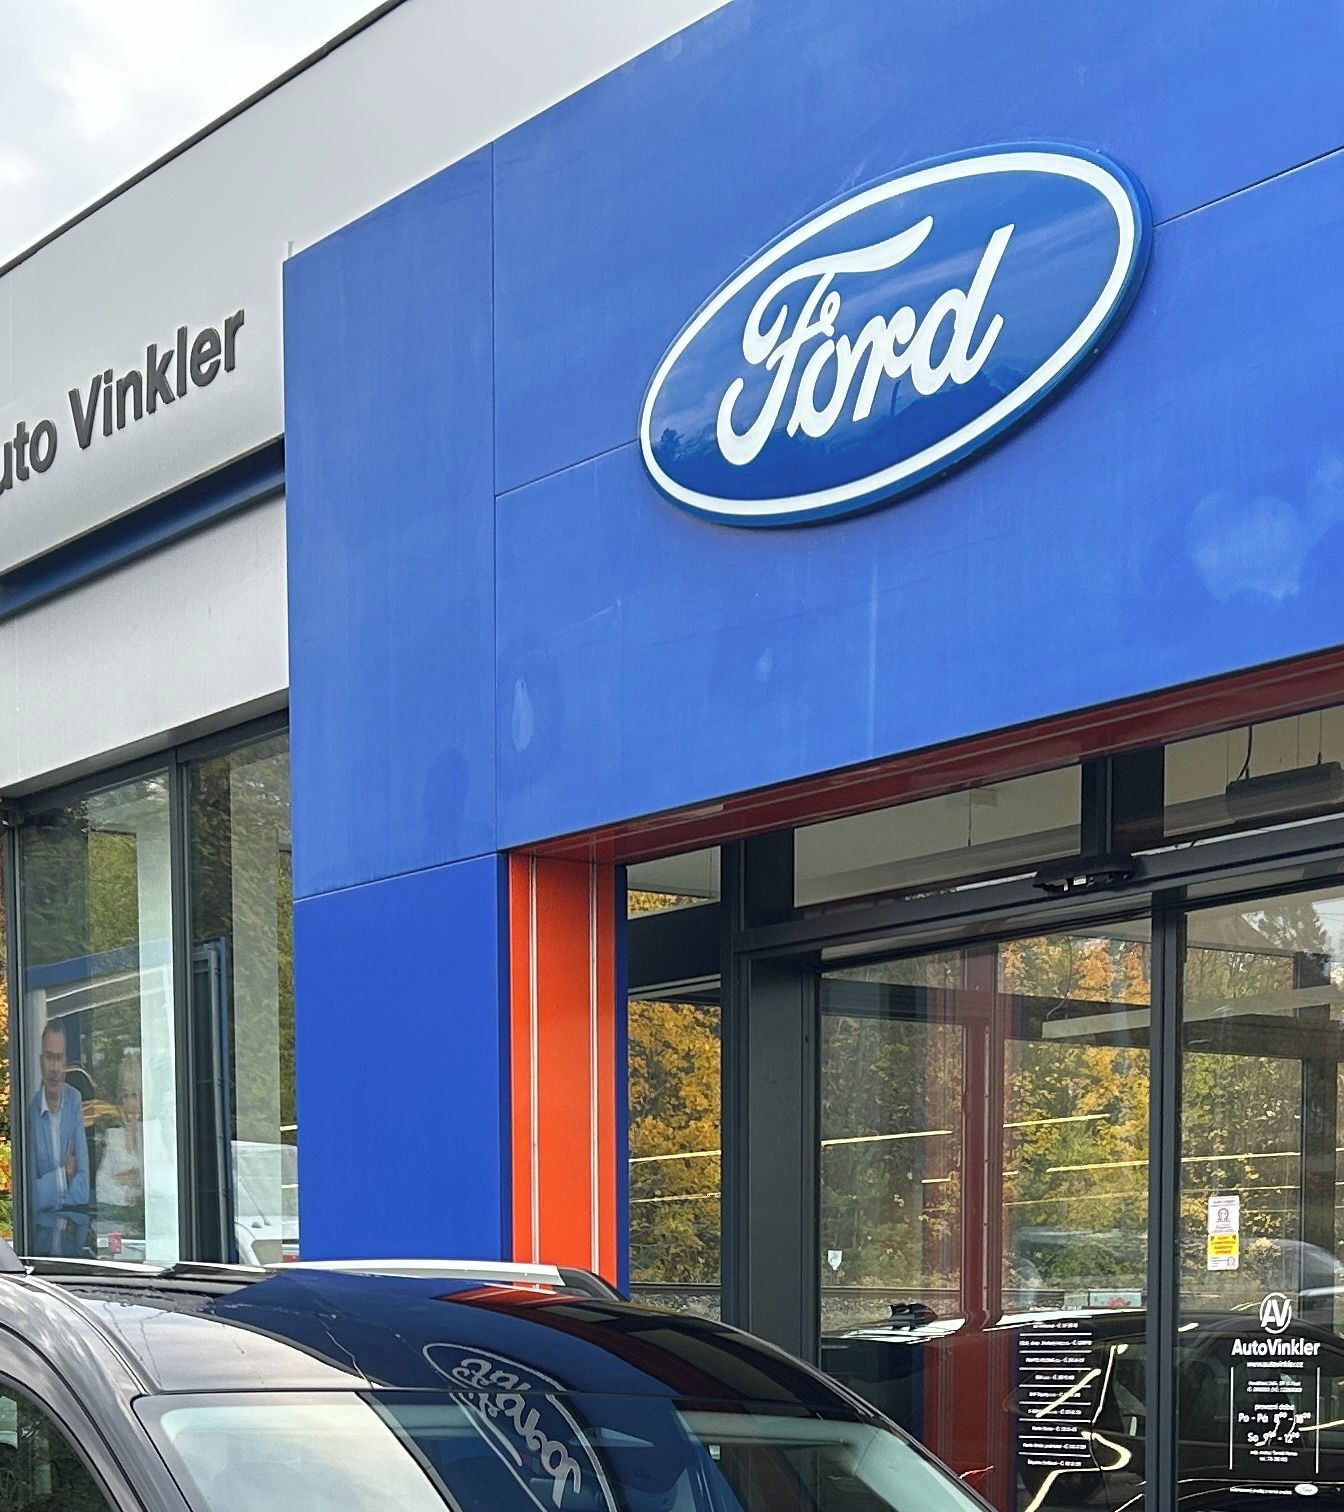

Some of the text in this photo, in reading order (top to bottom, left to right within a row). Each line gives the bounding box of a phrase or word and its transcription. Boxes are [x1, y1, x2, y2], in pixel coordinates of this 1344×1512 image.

[68, 308, 245, 450] Vinkler
[717, 215, 1015, 466] Ford
[1231, 1337, 1321, 1356] AutoVinkler
[1260, 1298, 1292, 1328] AV
